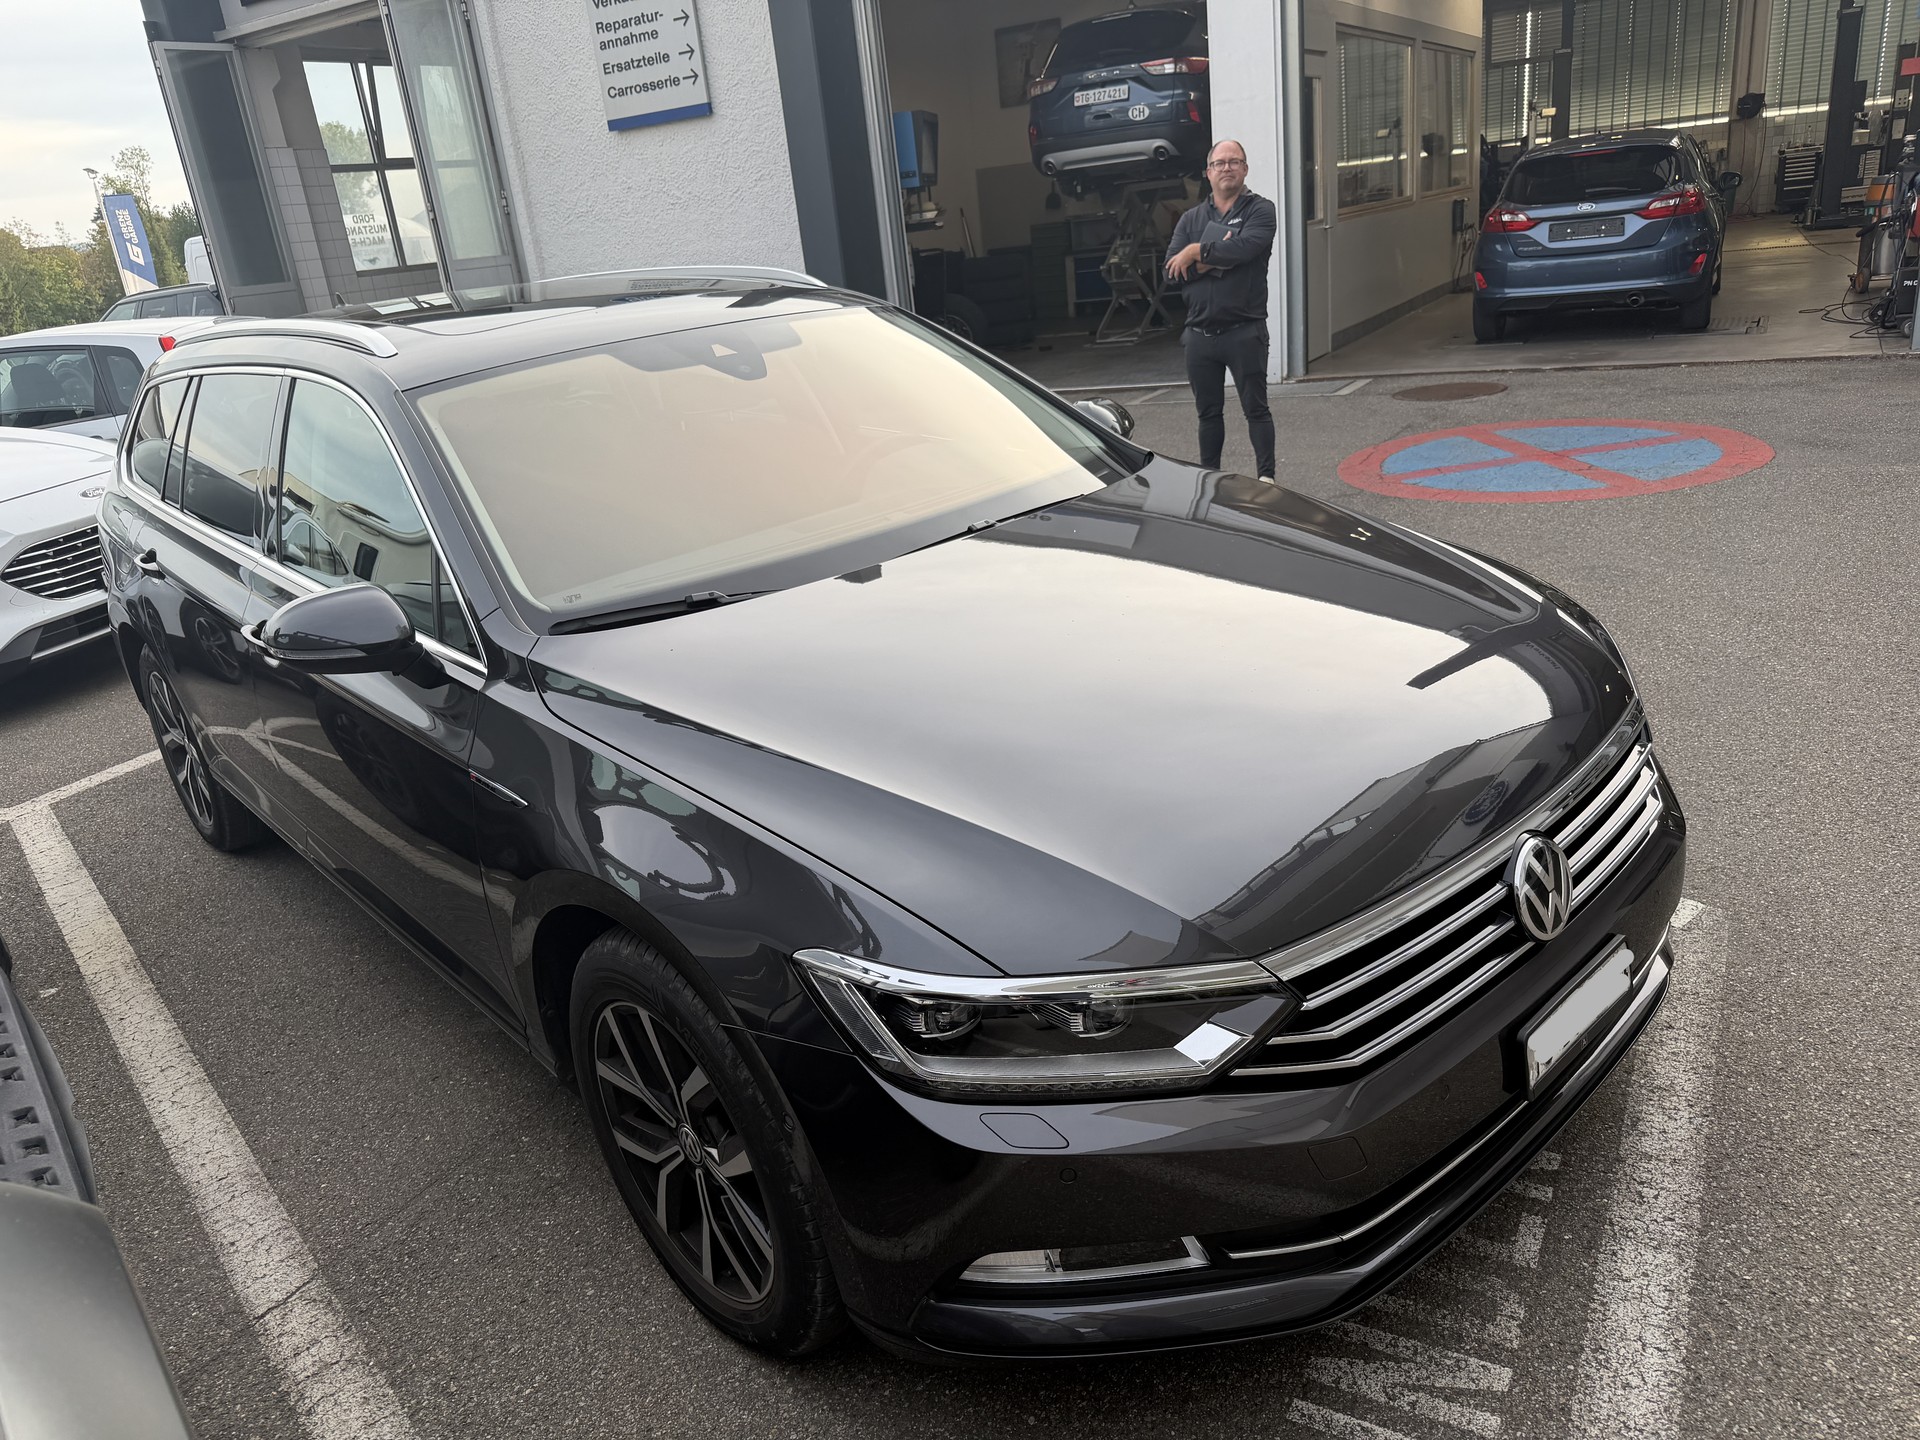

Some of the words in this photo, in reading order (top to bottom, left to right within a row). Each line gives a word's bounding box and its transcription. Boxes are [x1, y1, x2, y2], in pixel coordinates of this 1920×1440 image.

[595, 10, 664, 34] Reparatur-
[599, 29, 659, 51] annahme
[602, 51, 671, 75] Ersatzteile
[607, 75, 681, 99] Carrosserie
[1131, 107, 1146, 120] CH
[115, 209, 131, 239] GRENZ
[122, 208, 138, 244] GARAGE
